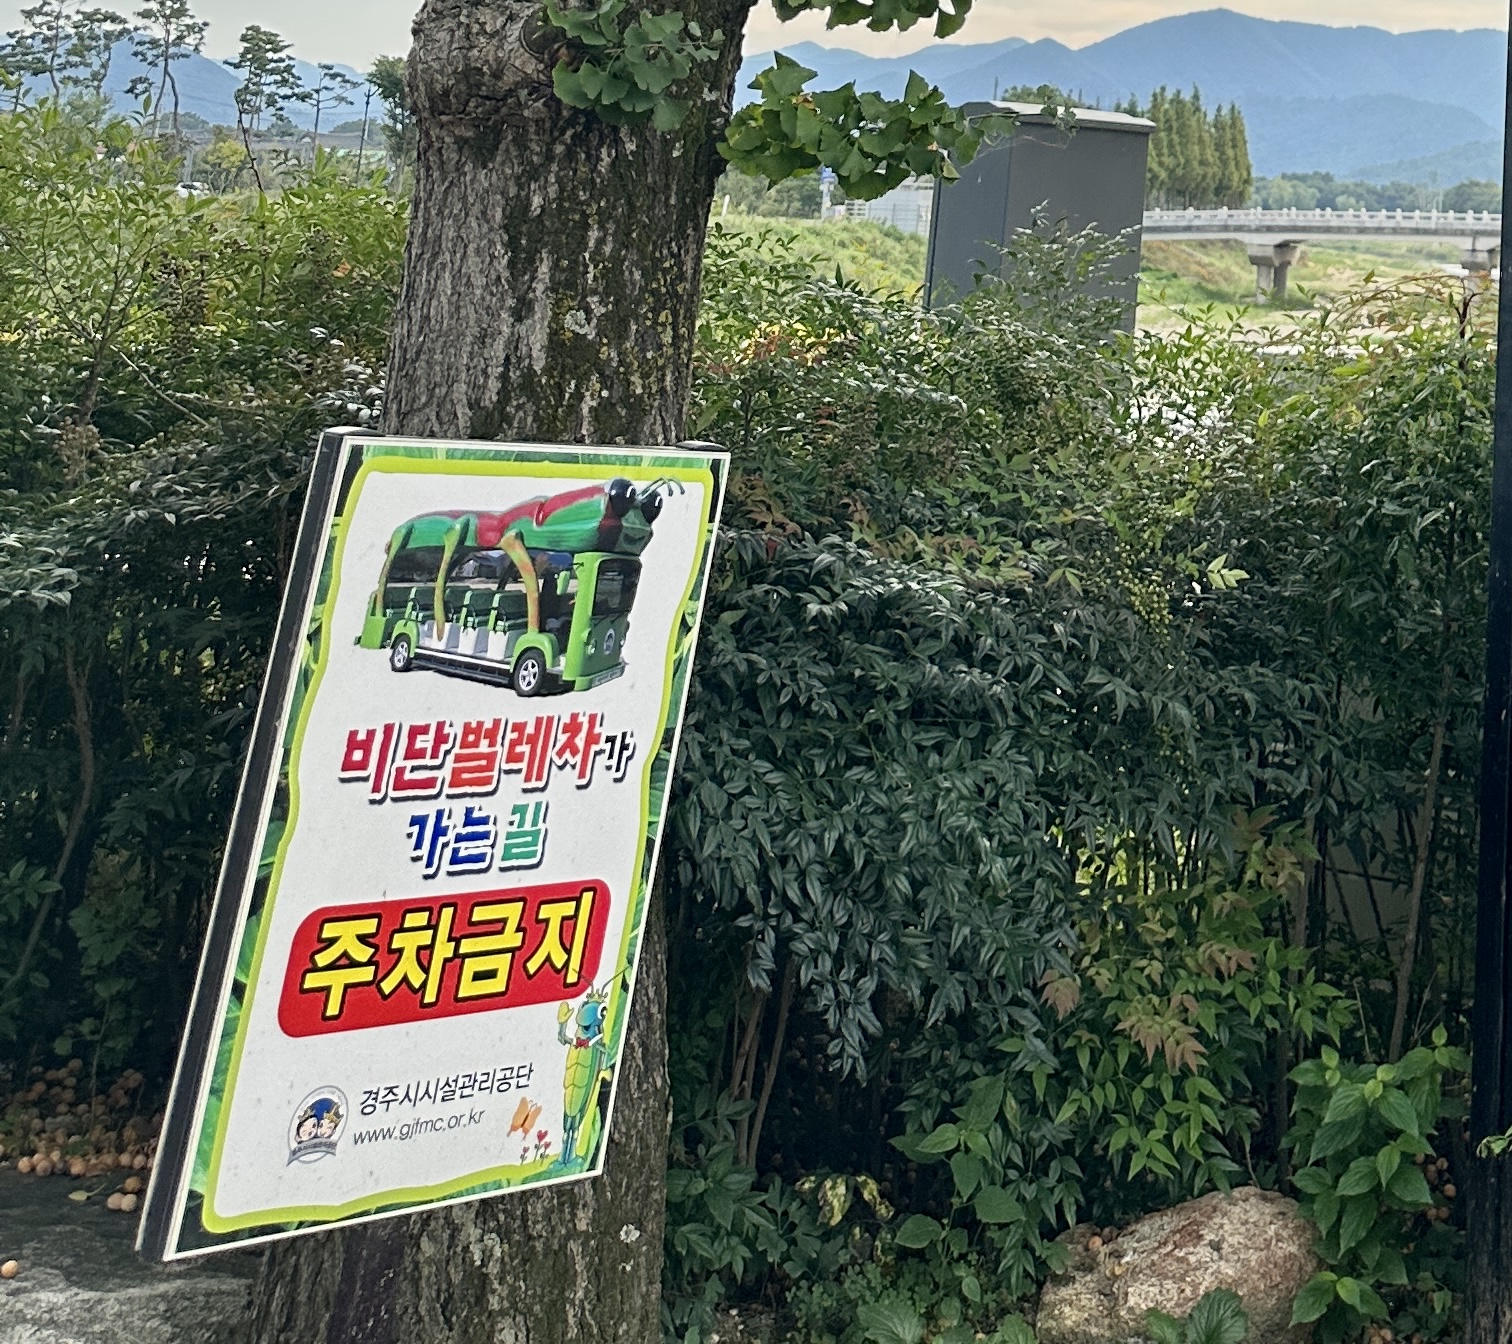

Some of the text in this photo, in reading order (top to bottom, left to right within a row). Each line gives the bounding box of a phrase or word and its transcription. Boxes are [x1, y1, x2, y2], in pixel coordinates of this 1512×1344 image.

[339, 712, 635, 800] 비단벌레차가
[500, 800, 546, 868] 길
[301, 889, 596, 1018] 주차금지
[360, 1062, 534, 1115] 경주시시설관리공단
[353, 1107, 485, 1145] www.gjfmc.or.kr
